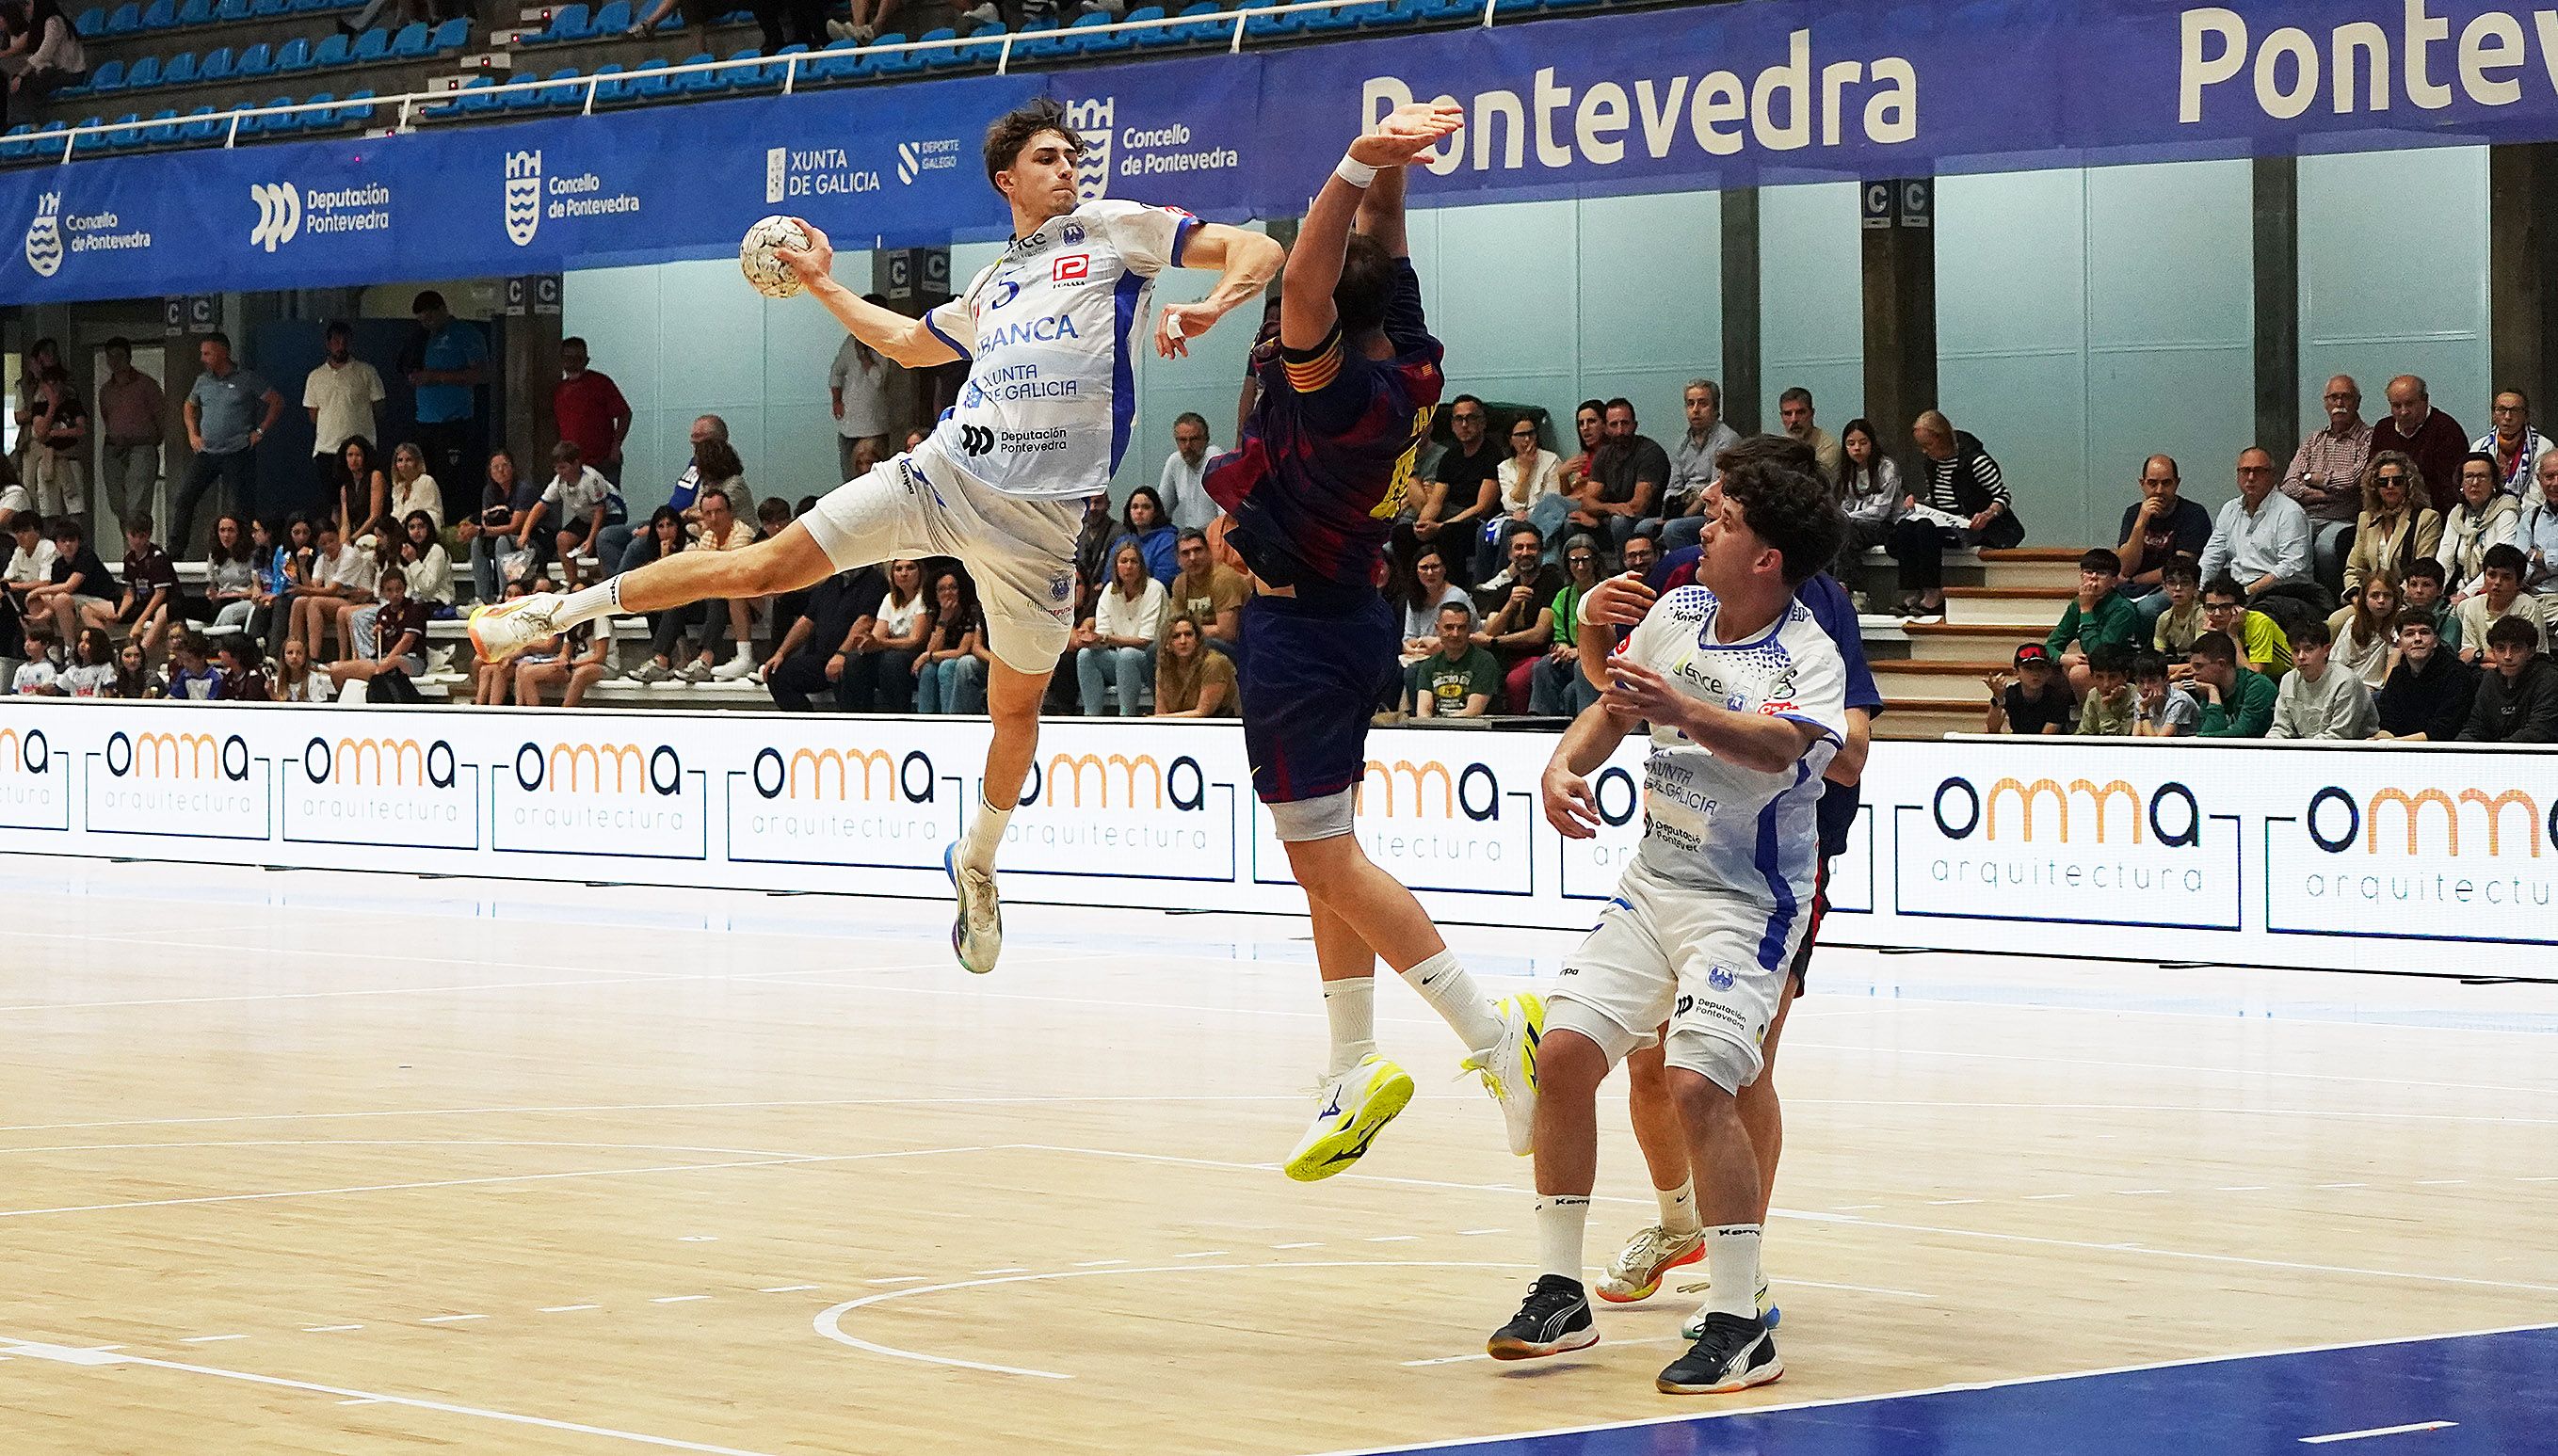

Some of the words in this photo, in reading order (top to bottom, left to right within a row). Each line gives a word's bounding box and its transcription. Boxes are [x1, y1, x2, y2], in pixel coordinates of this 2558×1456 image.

[922, 138, 959, 154] DEPORTE
[1121, 123, 1191, 149] Concello
[791, 149, 847, 171] XUNTA
[922, 155, 957, 169] GALEGO
[1120, 155, 1142, 176] de
[1144, 146, 1238, 174] Pontevedra
[548, 173, 600, 196] Concello
[789, 174, 811, 196] DE
[814, 171, 880, 195] GALICIA
[307, 183, 389, 215] Deputación
[548, 200, 565, 218] de
[566, 194, 639, 216] Pontevedra
[1868, 184, 1888, 214] C
[1906, 183, 1924, 211] C
[307, 210, 389, 233] Pontevedra
[86, 232, 151, 251] Pontevedra
[892, 261, 907, 286] C
[928, 254, 946, 279] C
[509, 280, 522, 303] C
[539, 279, 556, 302] C
[991, 265, 1025, 310] 5
[193, 300, 209, 321] C
[984, 363, 1038, 389] XUNTA
[1005, 380, 1078, 400] GALICIA
[1000, 440, 1067, 453] Pontevedra
[1001, 427, 1067, 443] Deputación
[106, 730, 249, 782] omma
[304, 736, 456, 789] omma
[515, 742, 681, 796] omma
[753, 746, 934, 804] omma
[1650, 760, 1694, 785] XUNTA
[105, 790, 250, 813] arquitectura
[303, 798, 458, 822] arquitectura
[1665, 782, 1717, 815] GALICIA
[514, 806, 683, 830] arquitectura
[1933, 776, 2201, 847] omma
[752, 813, 937, 840] arquitectura
[1006, 822, 1207, 850] arquitectura
[1655, 821, 1701, 844] Deputació
[1931, 856, 2202, 892] arquitectura
[1696, 1005, 1745, 1031] Pontevedra
[1697, 998, 1746, 1023] Deputación
